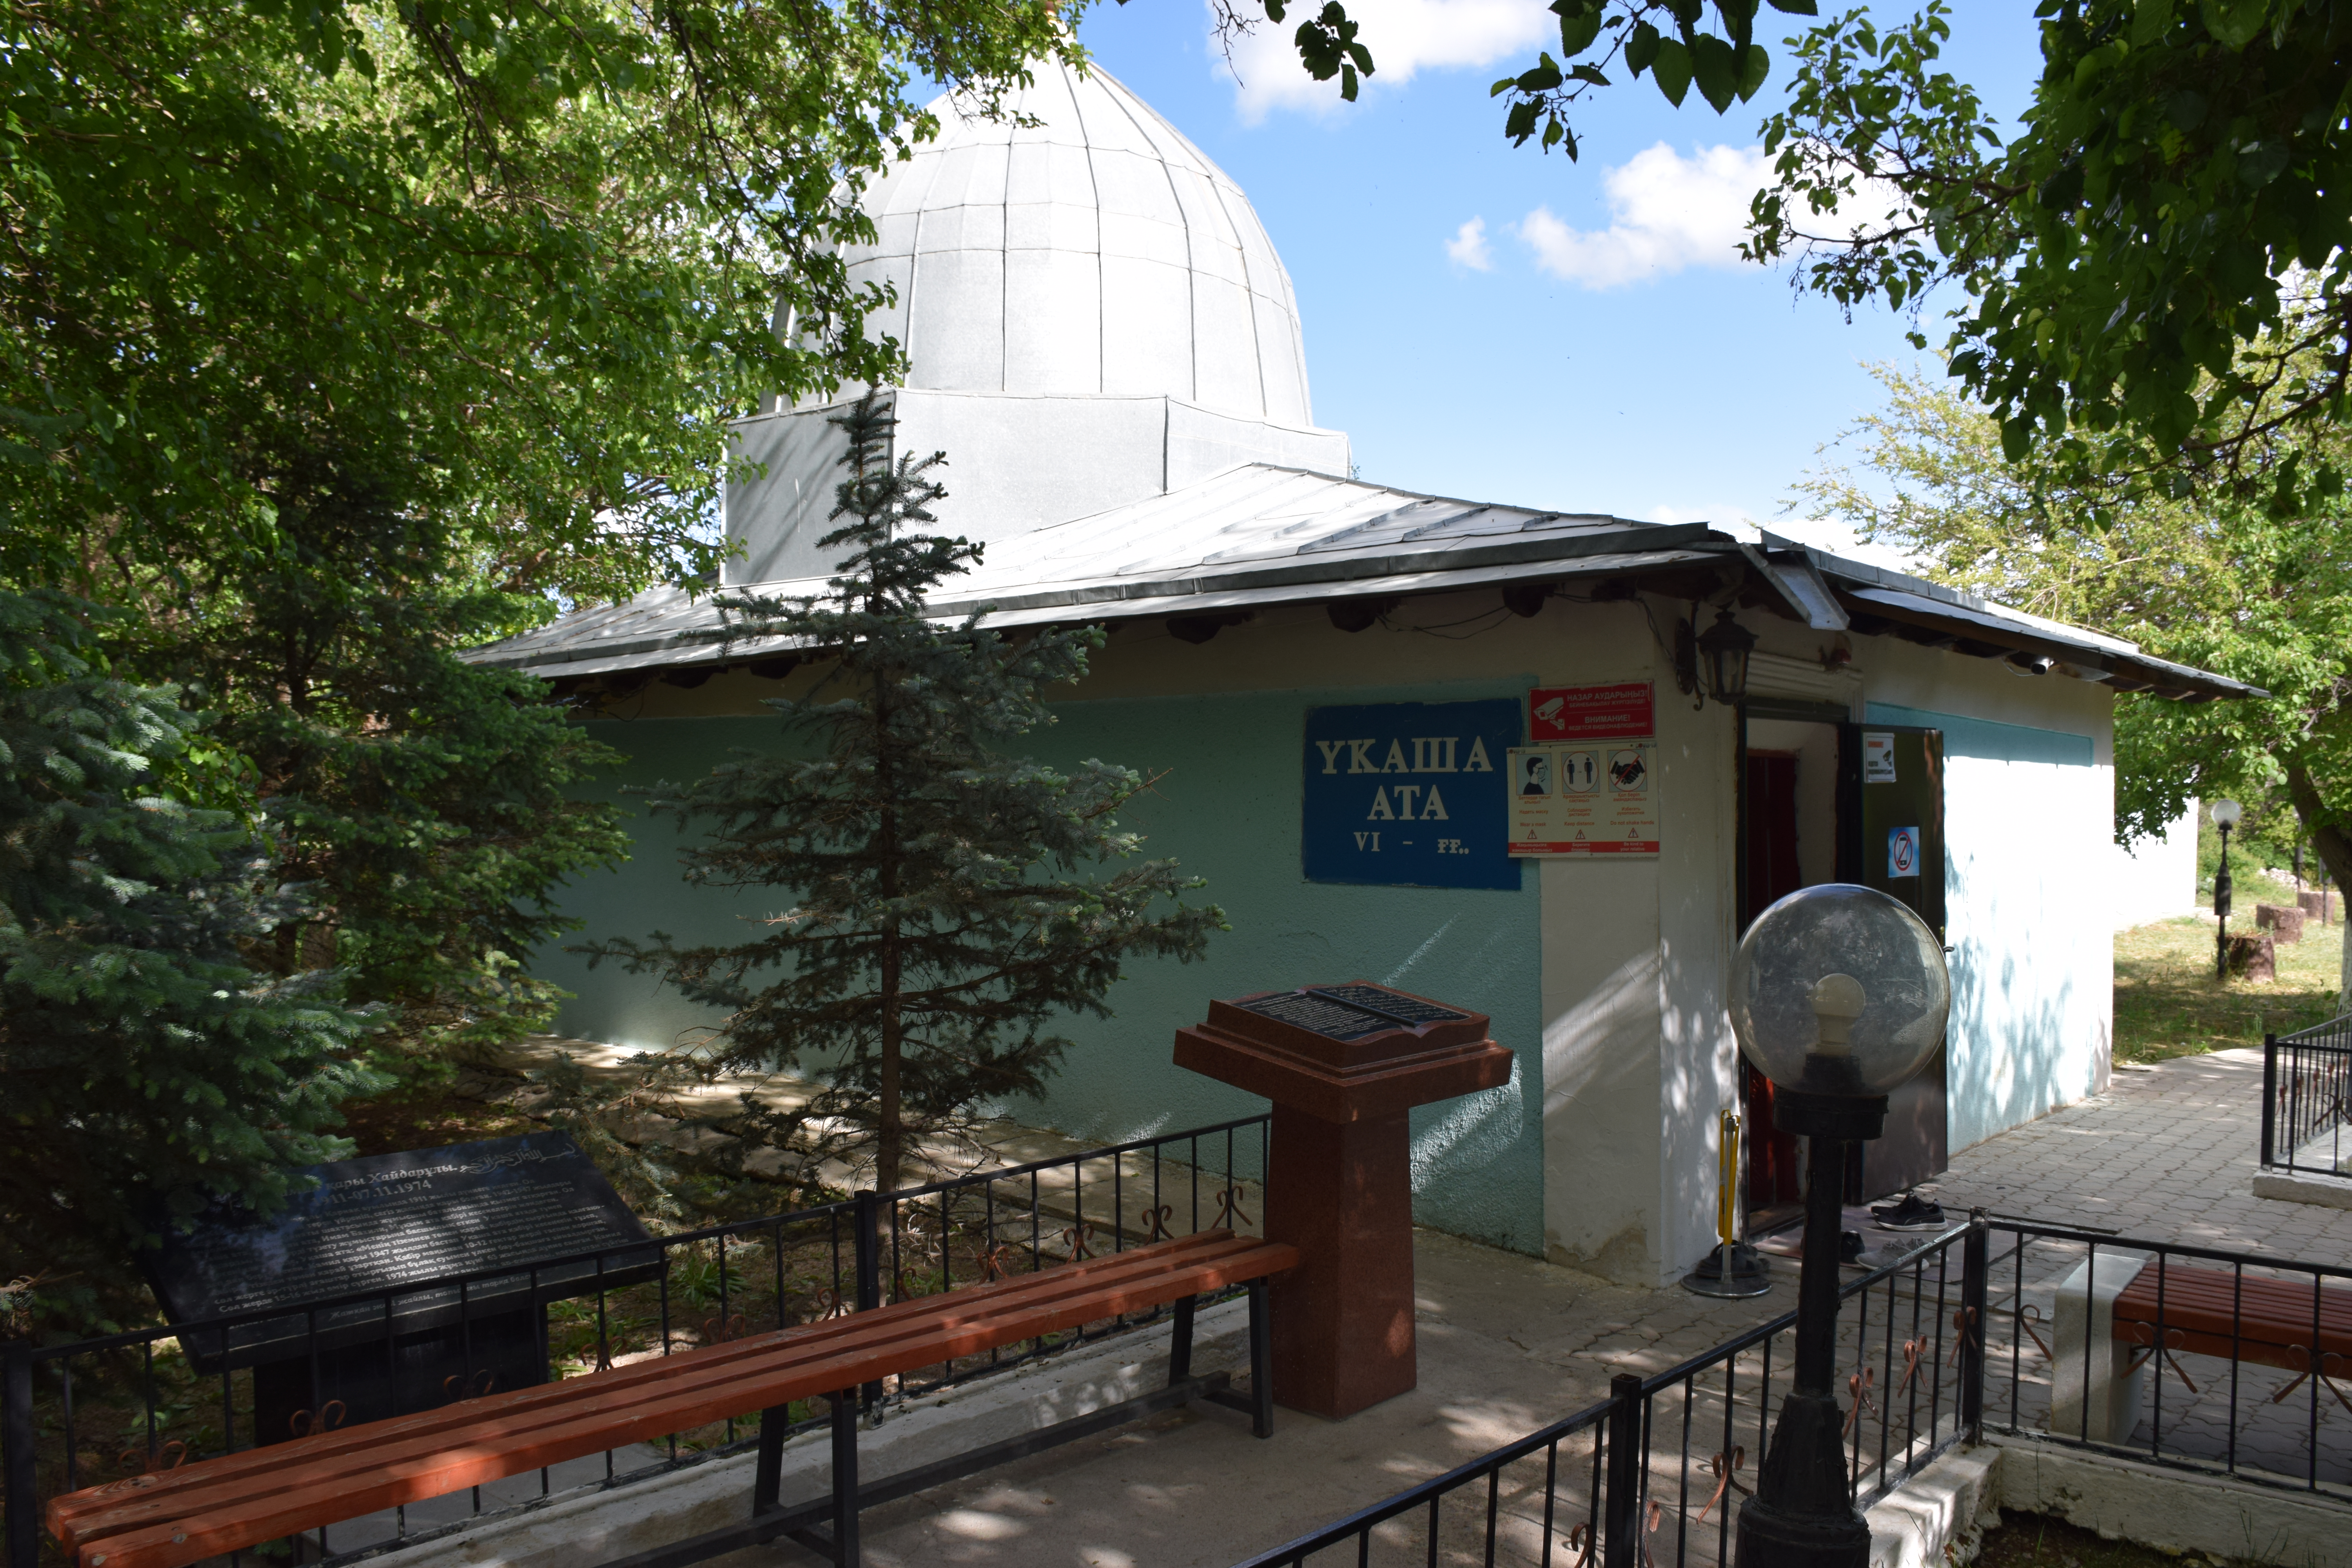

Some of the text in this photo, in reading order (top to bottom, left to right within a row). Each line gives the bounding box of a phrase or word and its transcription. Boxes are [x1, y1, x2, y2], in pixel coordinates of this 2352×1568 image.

[1595, 690, 1648, 701] АУДАРЫҢЫЗ!
[1585, 715, 1631, 724] ВНИМАНИЕ!
[1367, 784, 1449, 820] АТА
[1354, 831, 1381, 852] VI
[465, 1240, 488, 1248] 10-12
[369, 1249, 391, 1258] 1947
[275, 1292, 301, 1301] 15-16
[386, 1271, 408, 1280] 1974
